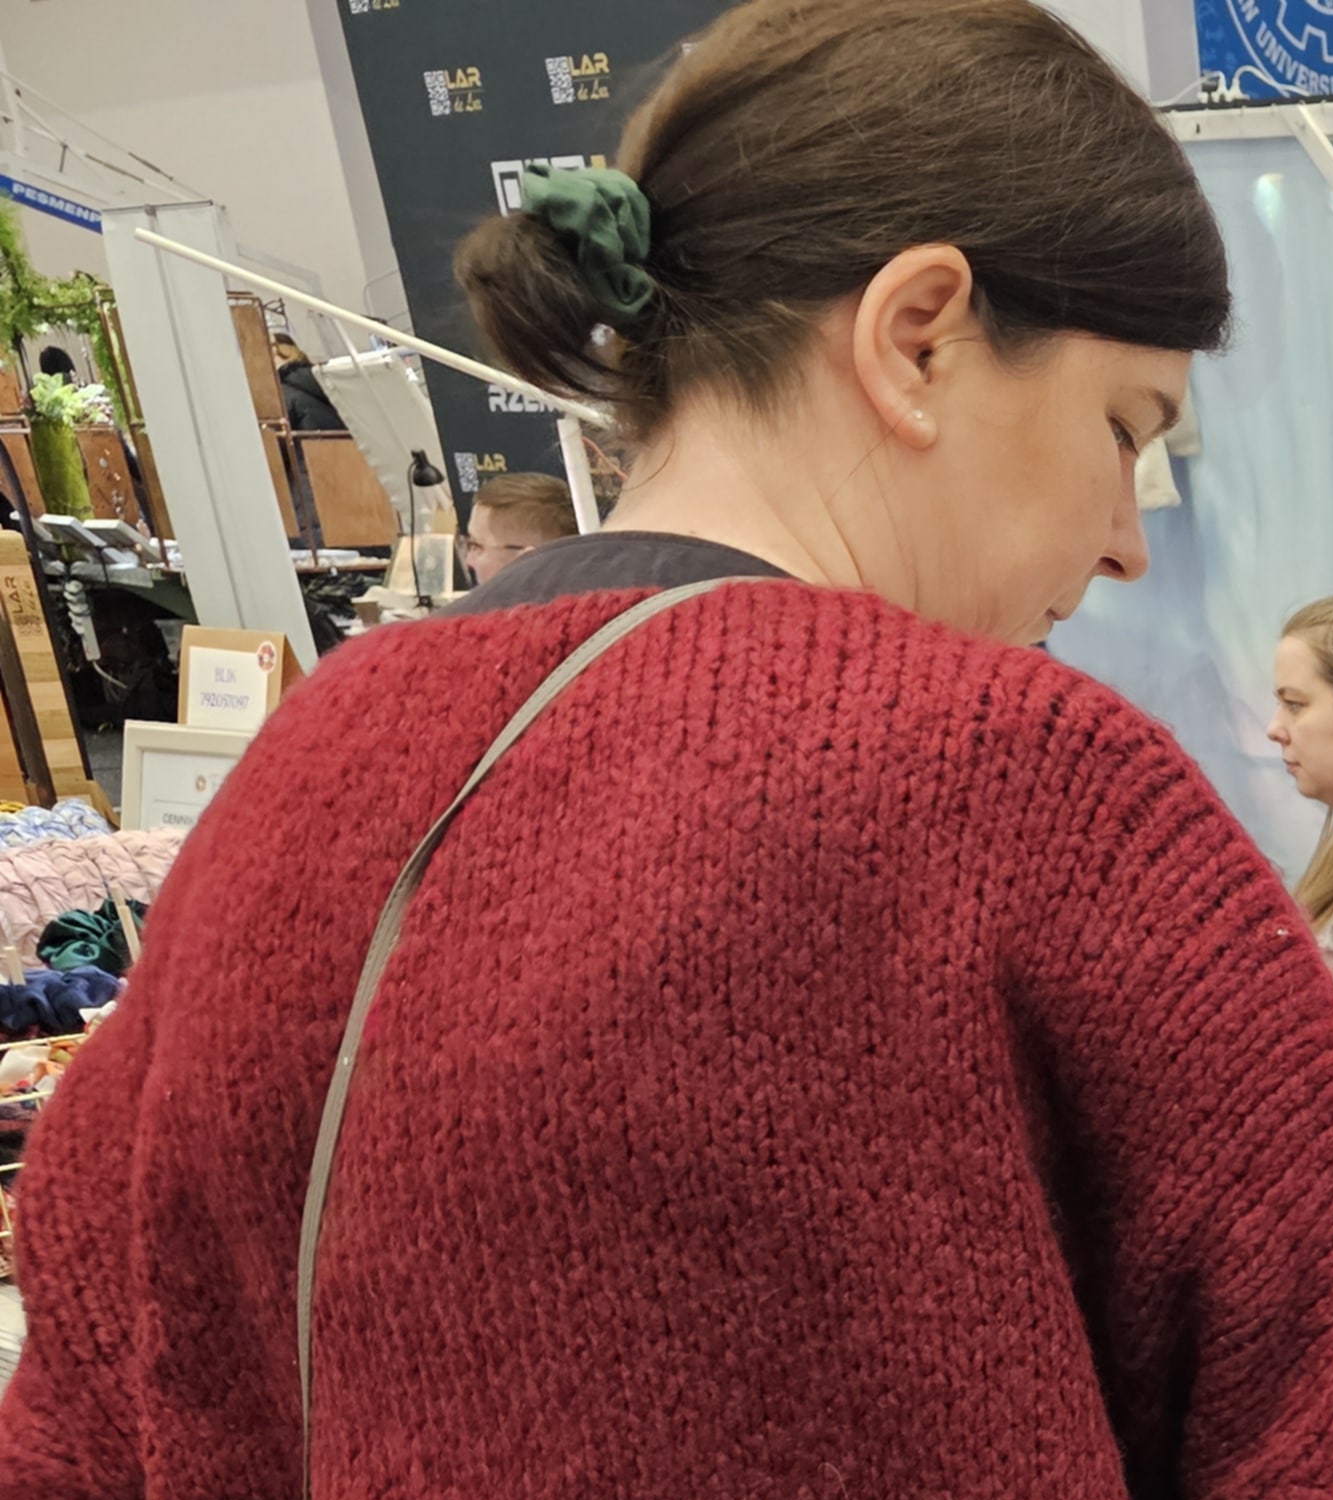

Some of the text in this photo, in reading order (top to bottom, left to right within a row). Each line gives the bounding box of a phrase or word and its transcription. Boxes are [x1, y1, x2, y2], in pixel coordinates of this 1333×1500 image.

[568, 52, 610, 76] LAR
[444, 66, 482, 89] LAR
[473, 452, 508, 473] LAR
